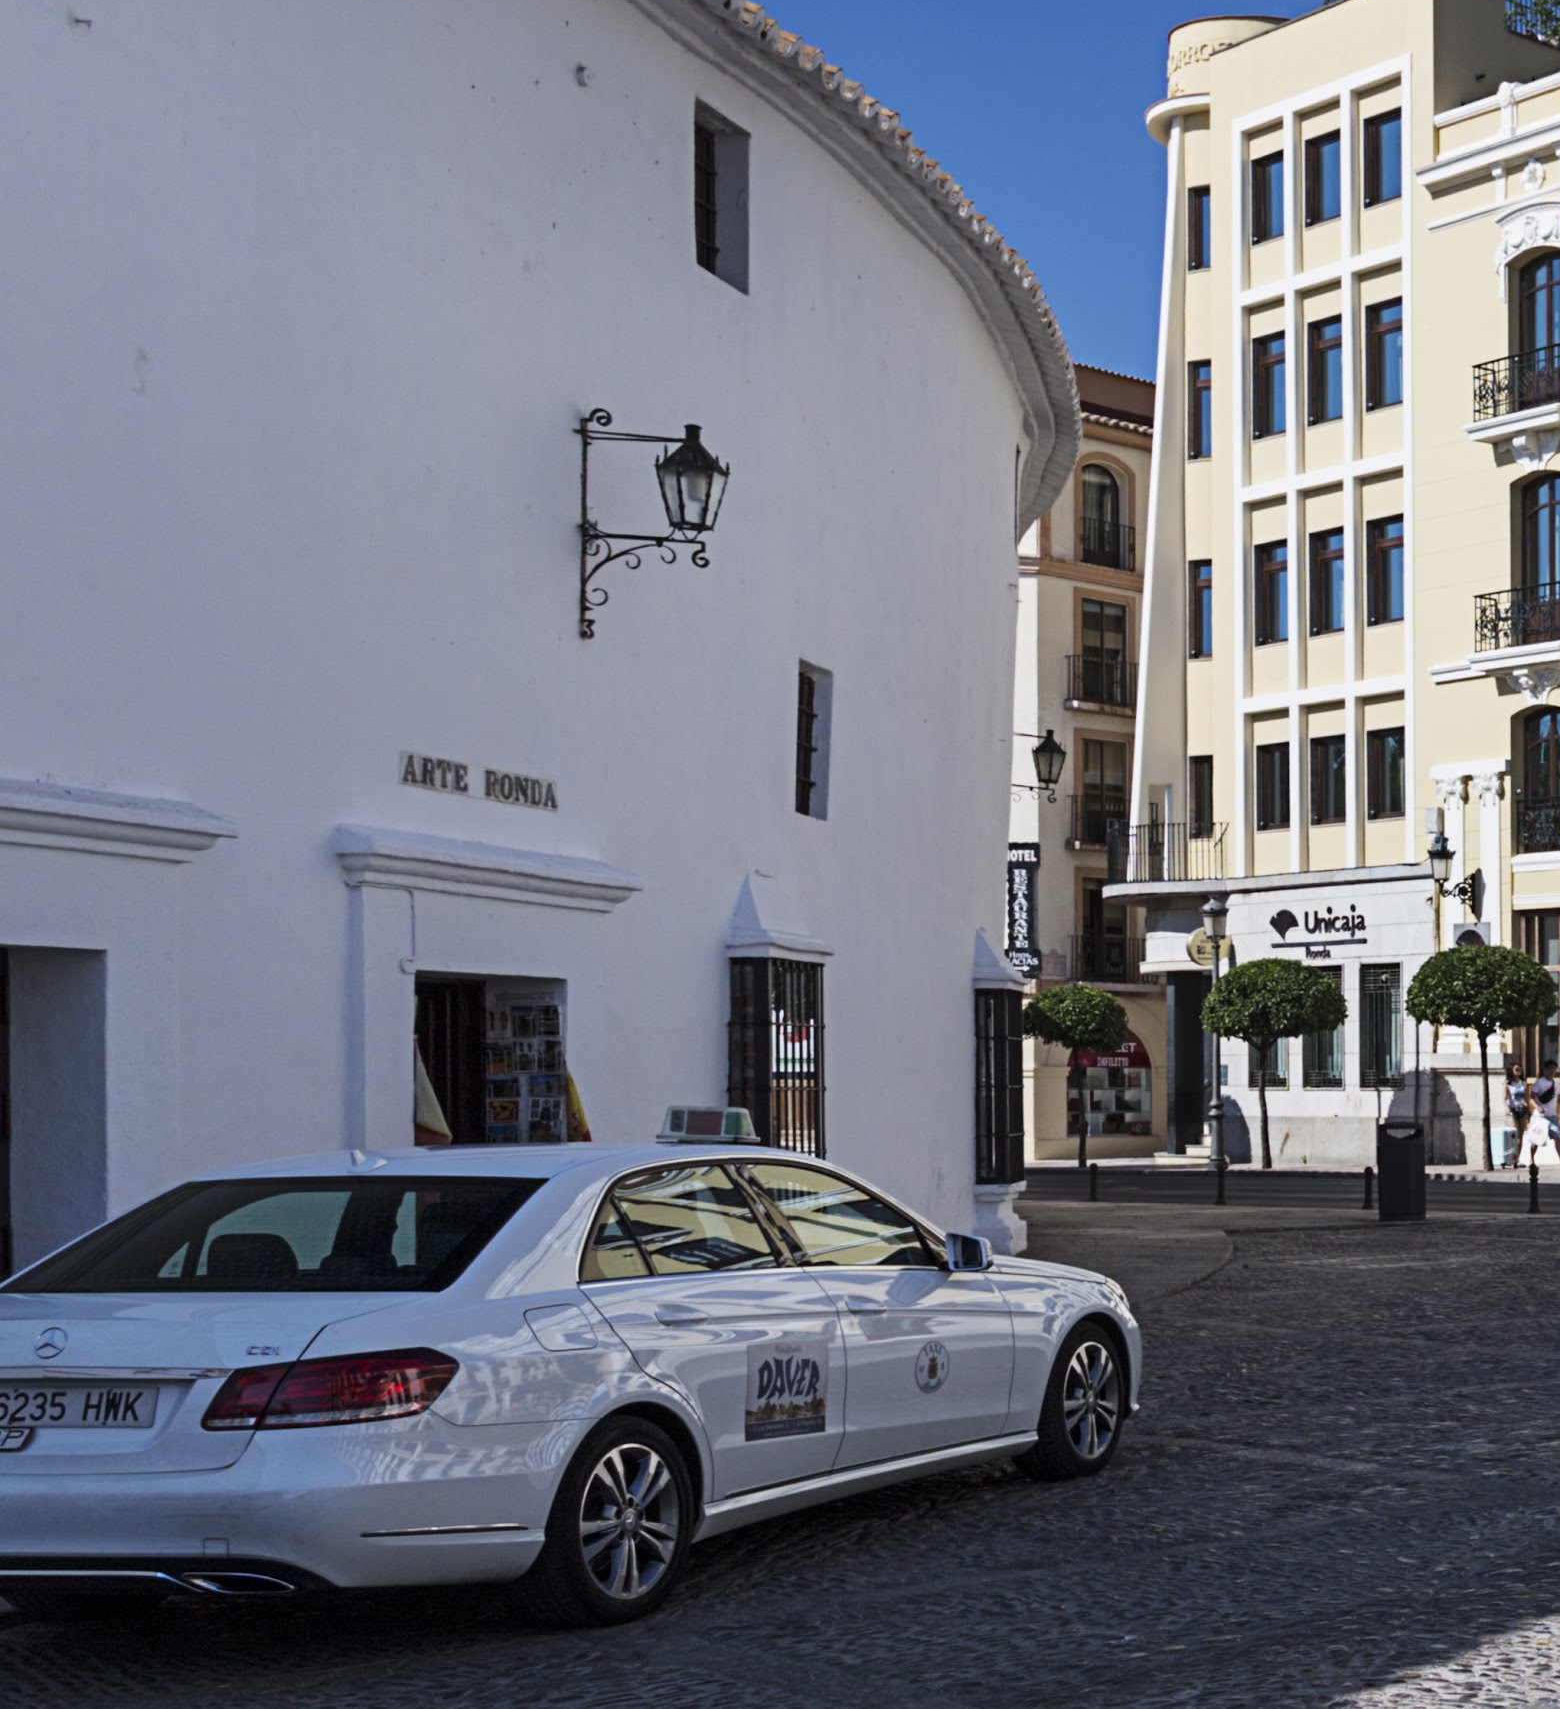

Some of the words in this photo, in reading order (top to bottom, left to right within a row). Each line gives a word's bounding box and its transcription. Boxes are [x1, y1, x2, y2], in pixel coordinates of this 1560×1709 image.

[402, 754, 468, 793] ARTE
[485, 769, 558, 809] RONDA
[1013, 868, 1028, 948] RESTAURANTE
[1304, 904, 1366, 938] Unicaja
[1305, 946, 1331, 959] Ronda
[246, 1346, 281, 1356] CDI
[922, 1342, 943, 1358] TAXI
[757, 1354, 820, 1401] DAVER
[82, 1391, 143, 1423] HWK
